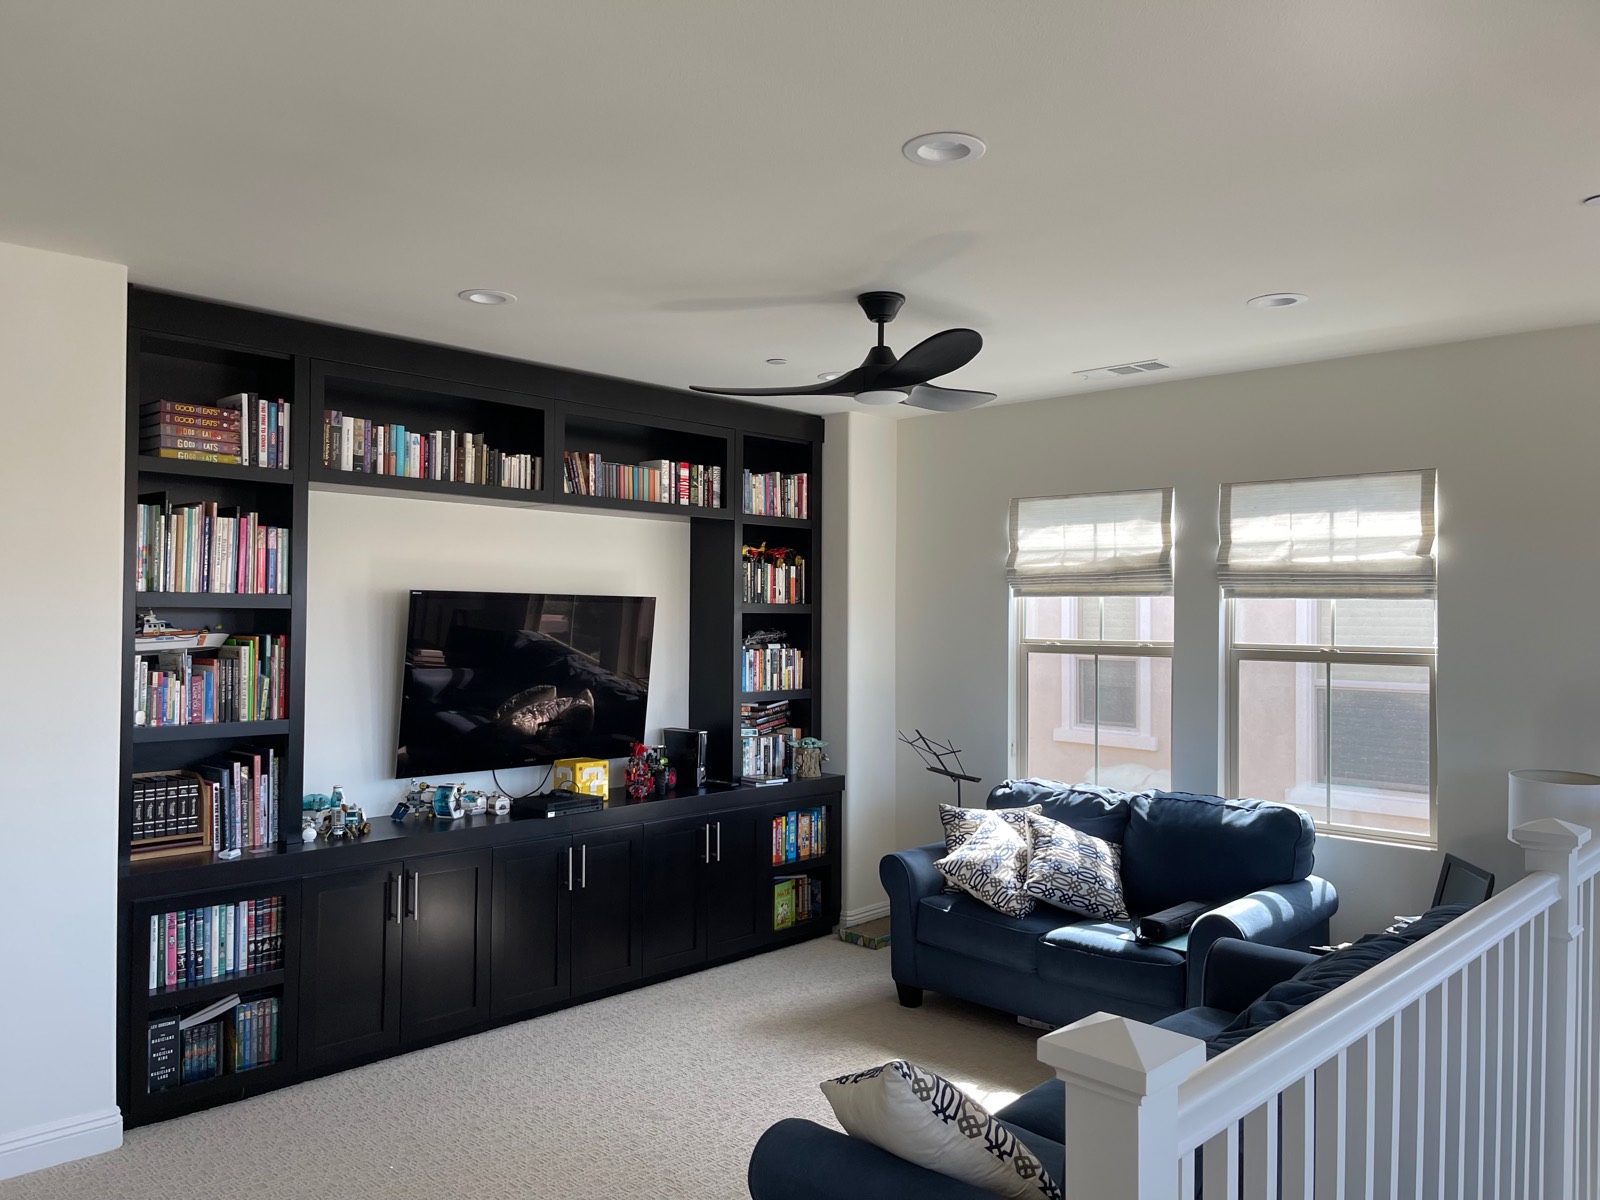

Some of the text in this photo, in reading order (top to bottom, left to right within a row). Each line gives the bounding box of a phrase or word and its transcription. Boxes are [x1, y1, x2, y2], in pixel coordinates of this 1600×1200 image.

[175, 404, 195, 412] GOOD
[174, 416, 194, 424] GOOD
[176, 426, 195, 436] GOOD
[177, 439, 218, 452] GOOD EATS
[178, 452, 196, 460] GOOD
